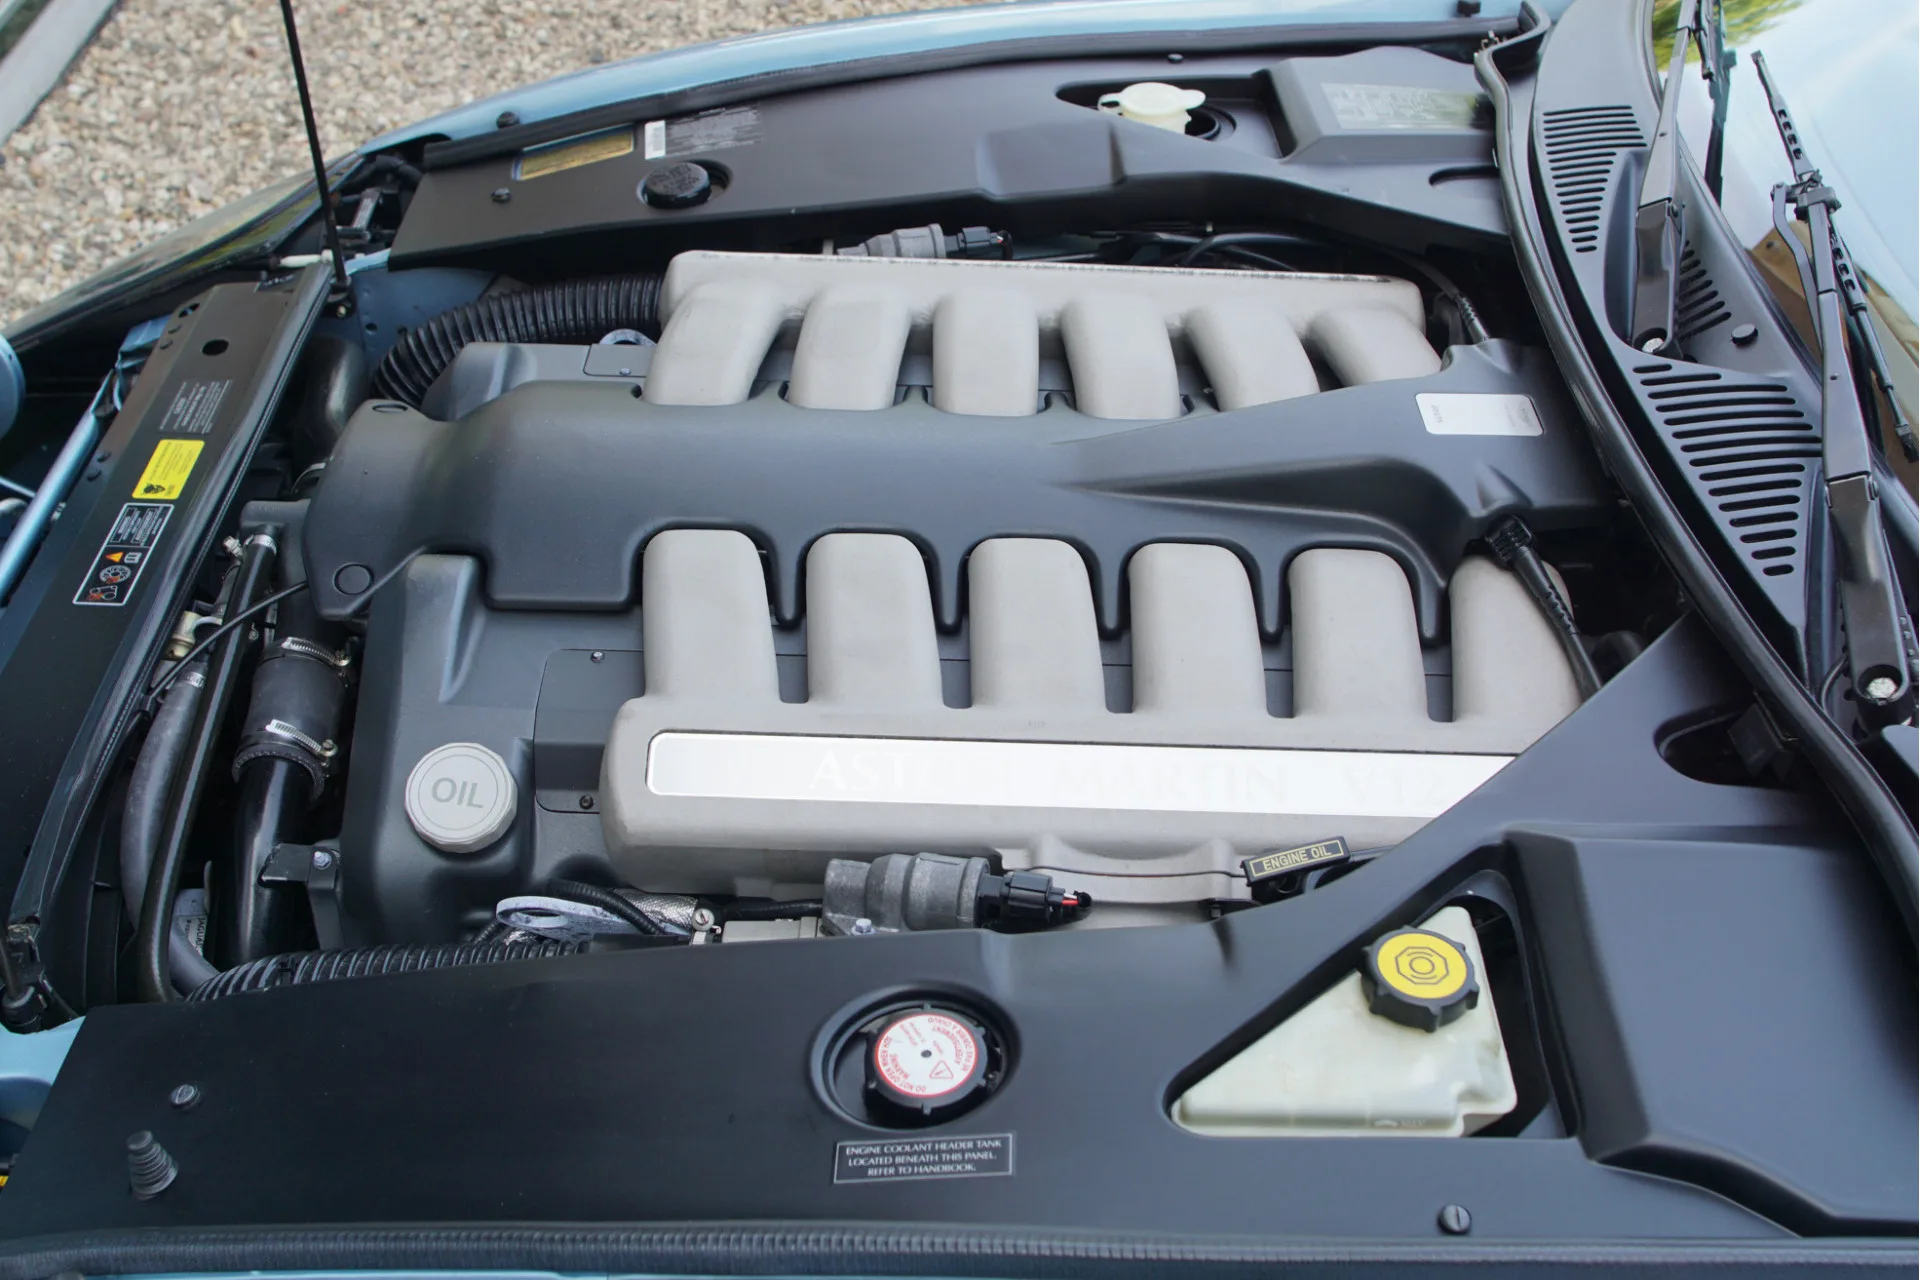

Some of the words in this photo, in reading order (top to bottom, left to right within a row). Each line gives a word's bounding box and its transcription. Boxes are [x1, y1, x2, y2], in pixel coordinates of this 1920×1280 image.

[432, 777, 484, 809] OIL
[1263, 850, 1308, 871] ENGINE
[1311, 845, 1332, 859] OIL
[846, 1146, 881, 1156] ENGINE
[884, 1143, 932, 1153] COOLANT
[935, 1141, 974, 1151] HEADER
[976, 1139, 1002, 1149] TANK
[848, 1157, 893, 1167] LOCATED
[895, 1154, 939, 1164] BENEATH
[941, 1152, 962, 1162] THIS
[964, 1150, 997, 1160] PANEL.
[867, 1167, 895, 1176] REFER
[898, 1166, 911, 1175] TO
[914, 1164, 976, 1174] HANDBOOK.
